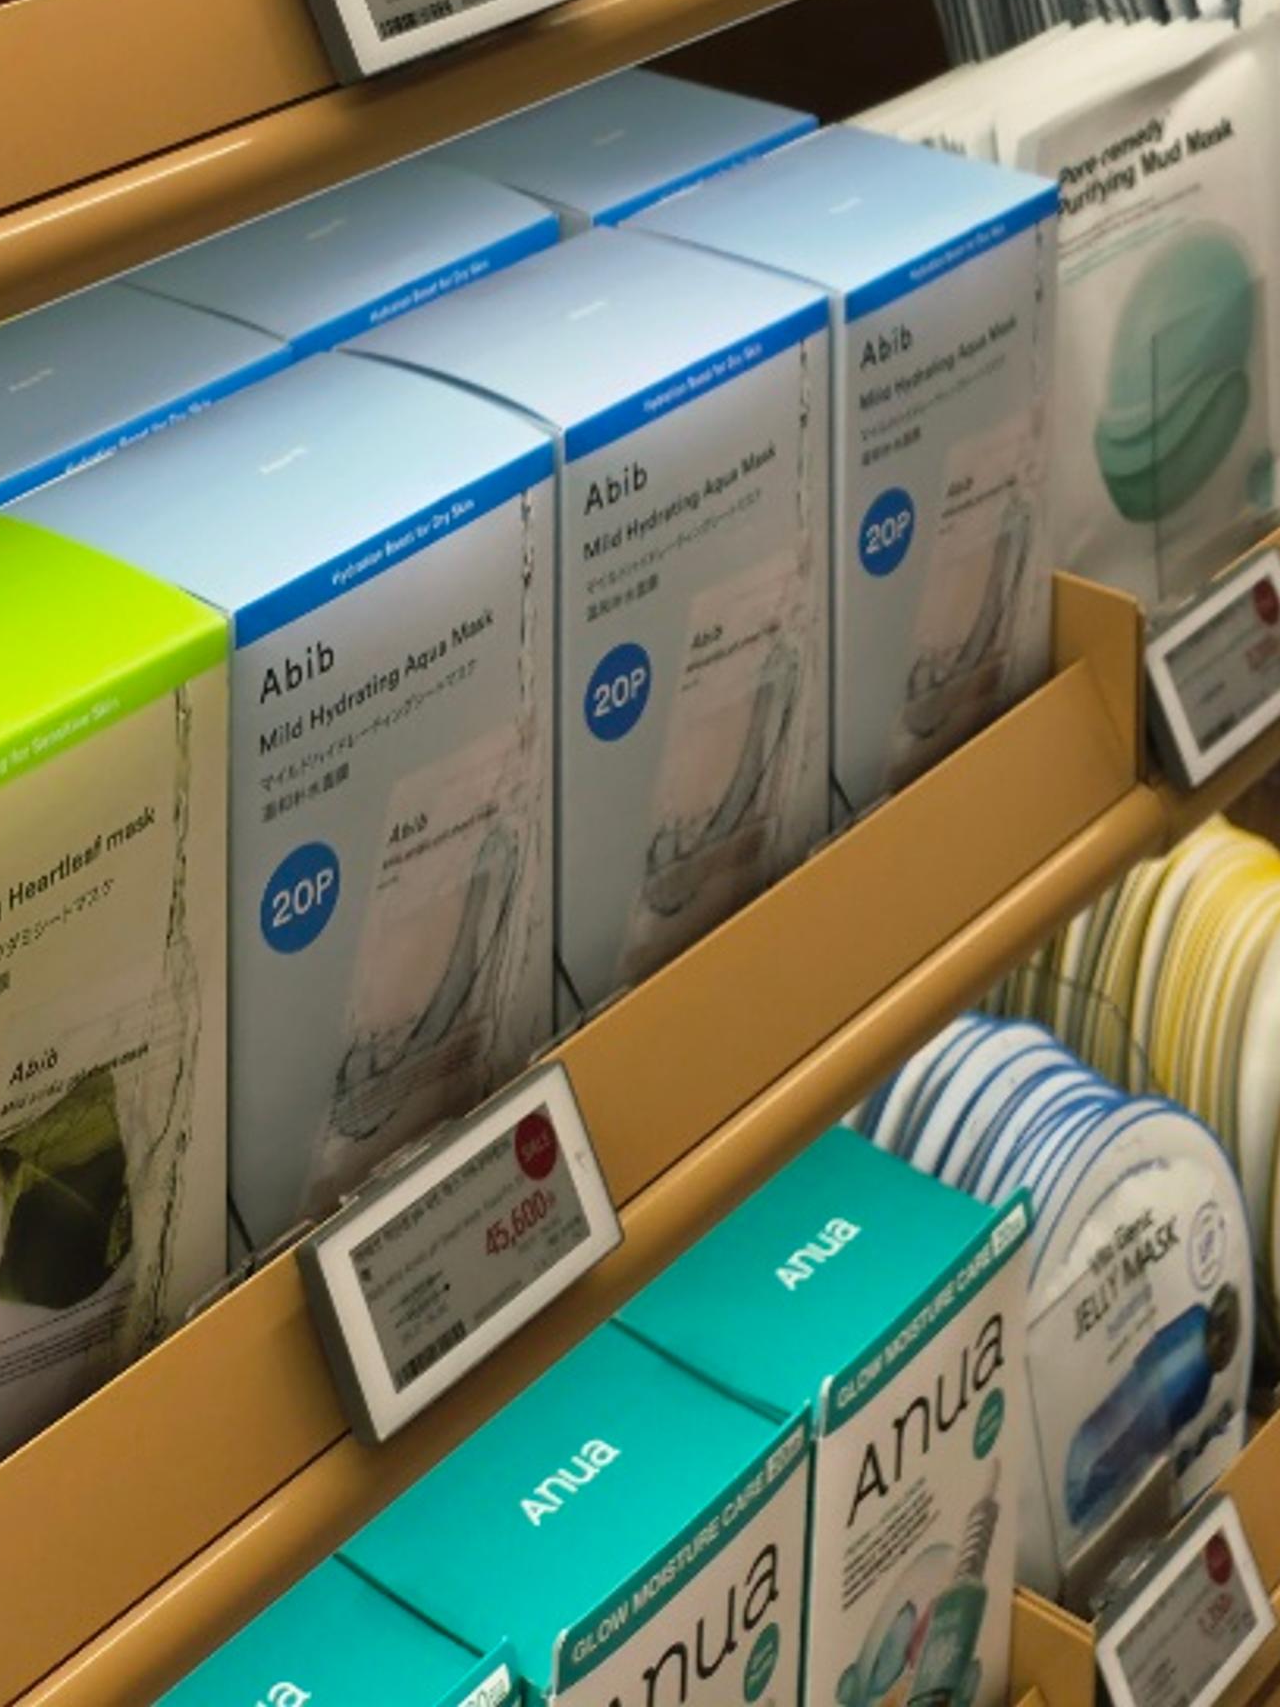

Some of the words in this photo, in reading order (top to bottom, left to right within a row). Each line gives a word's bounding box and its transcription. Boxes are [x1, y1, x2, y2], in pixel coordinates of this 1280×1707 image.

[1185, 117, 1232, 155] Mask
[858, 323, 914, 372] Abib
[582, 461, 648, 517] Abib
[582, 525, 621, 563] Mild
[625, 482, 700, 542] Hydrating
[702, 461, 739, 498] Aqua
[741, 441, 778, 476] Mask
[865, 510, 912, 557] 20P
[259, 638, 337, 704] Abib
[259, 715, 304, 757] Mild
[309, 665, 402, 732] Hydrating
[403, 637, 449, 680] Aqua
[450, 607, 495, 649] Mask
[593, 666, 648, 720] 20P
[8, 831, 104, 912] Heartleaf
[106, 806, 157, 852] mask
[269, 865, 335, 929] 20P
[775, 1216, 863, 1293] Anua
[1122, 1214, 1181, 1284] MASK
[845, 1310, 1006, 1528] Anua
[519, 1438, 622, 1528] Anua
[572, 1604, 632, 1664] GLOW
[631, 1514, 721, 1613] MOISTURE
